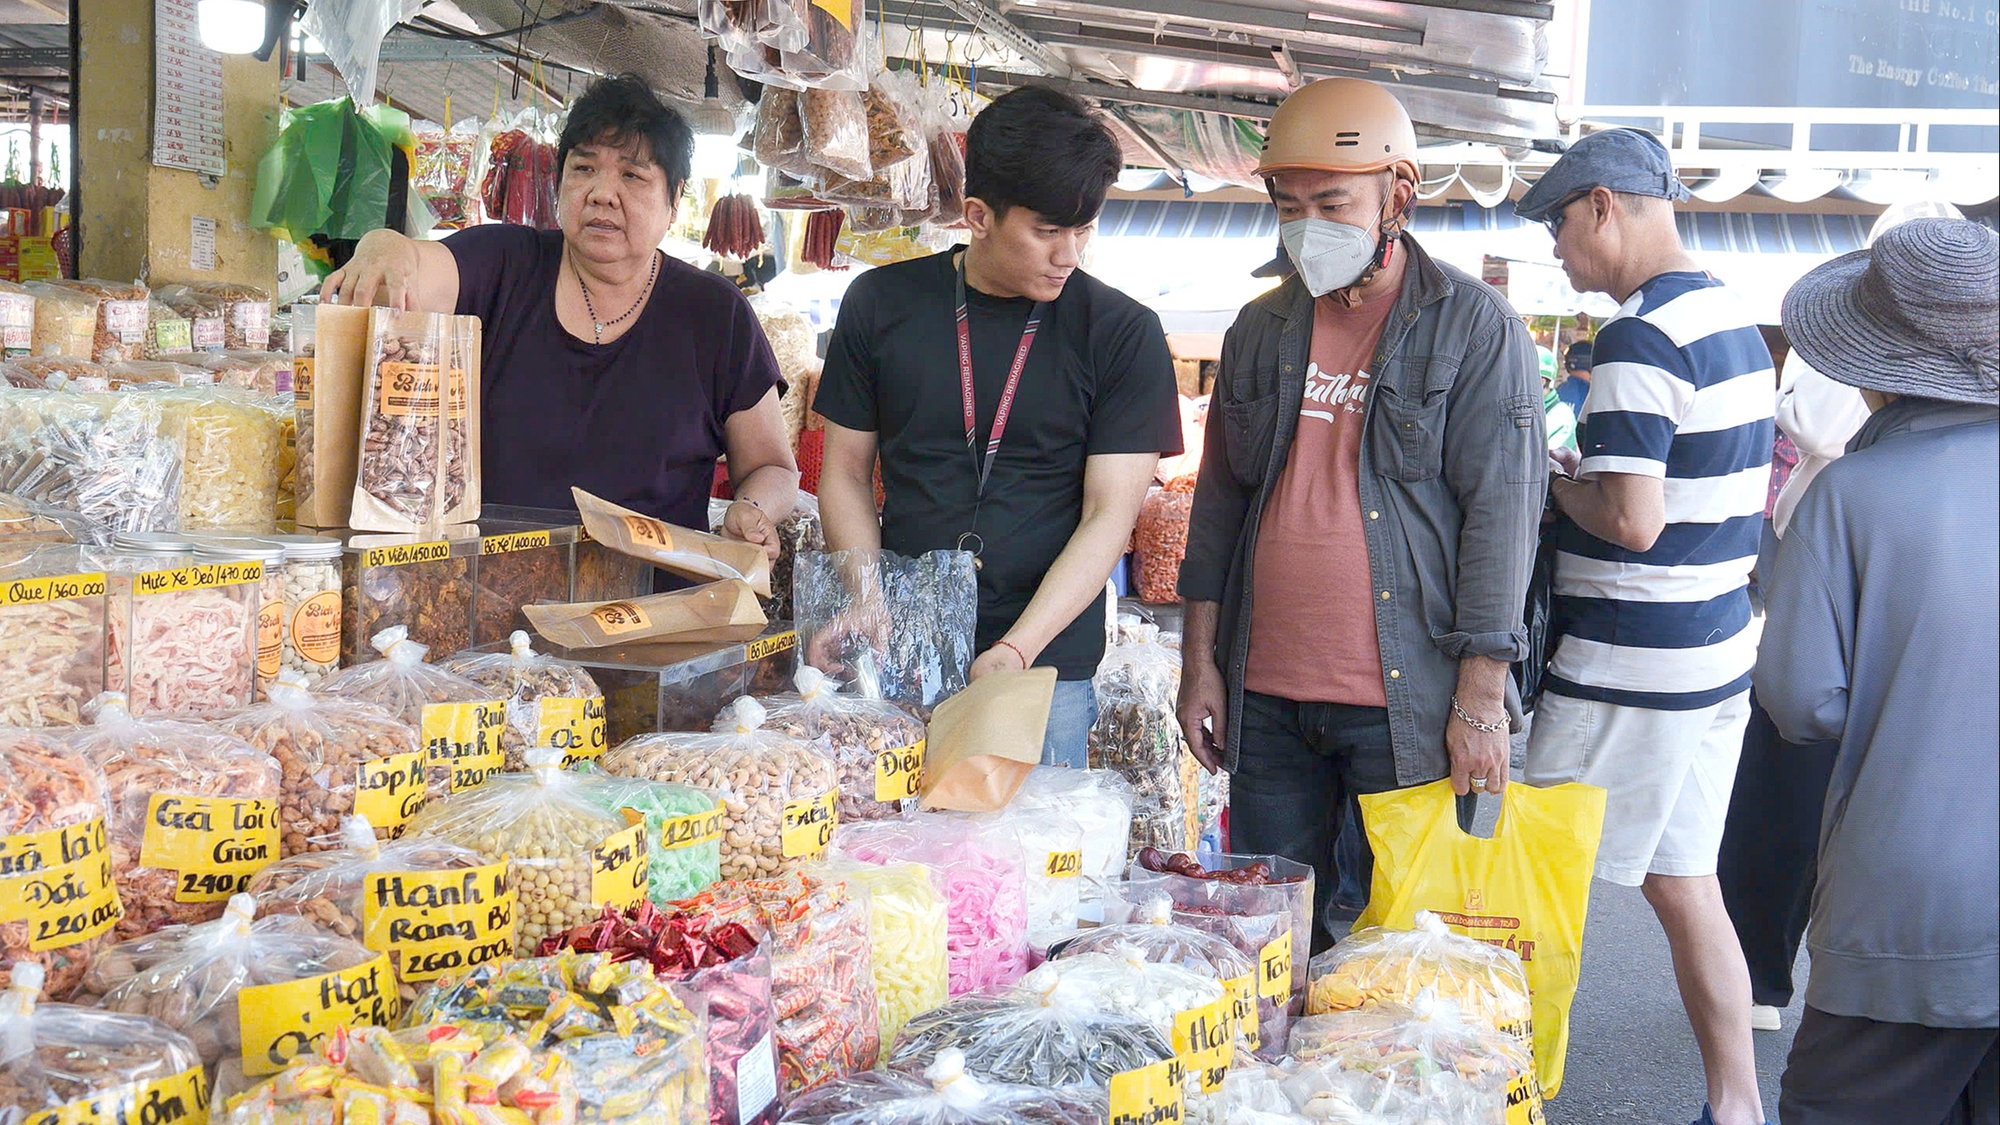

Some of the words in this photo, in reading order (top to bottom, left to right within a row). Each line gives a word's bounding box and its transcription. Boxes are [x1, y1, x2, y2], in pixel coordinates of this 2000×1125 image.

[1849, 54, 1873, 76] The
[1876, 58, 1922, 87] Energy
[960, 334, 969, 365] VAPING
[962, 366, 972, 417] REIMAGINED
[996, 395, 1011, 427] VAPING
[1006, 345, 1028, 395] REIMAGINED
